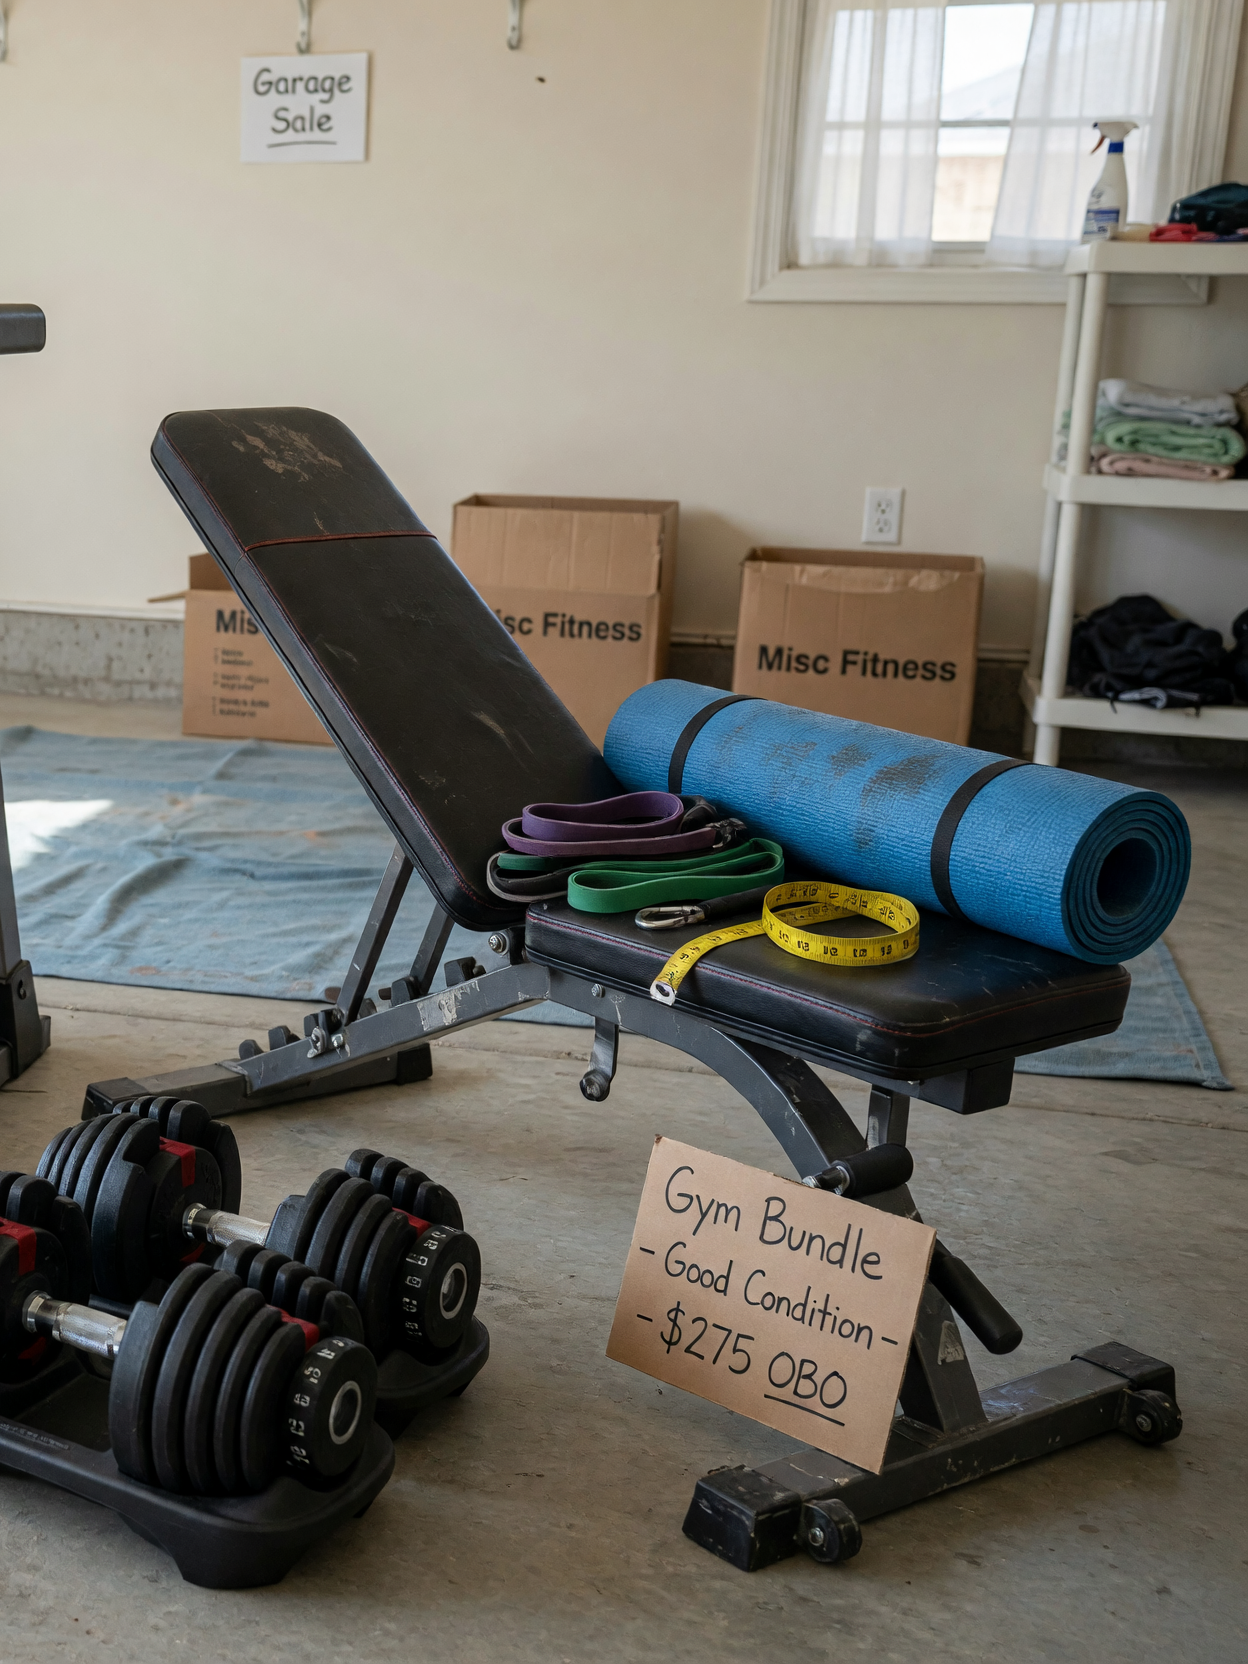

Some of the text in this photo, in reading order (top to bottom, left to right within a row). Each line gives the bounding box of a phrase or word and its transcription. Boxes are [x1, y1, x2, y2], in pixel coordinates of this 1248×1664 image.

[253, 67, 353, 104] Garage
[271, 104, 334, 134] Sale
[215, 608, 260, 636] Mis
[542, 611, 643, 642] Fitness
[757, 643, 958, 682] Misc Fitness
[664, 1165, 883, 1281] Gym Bundle
[767, 1351, 848, 1410] OBO
